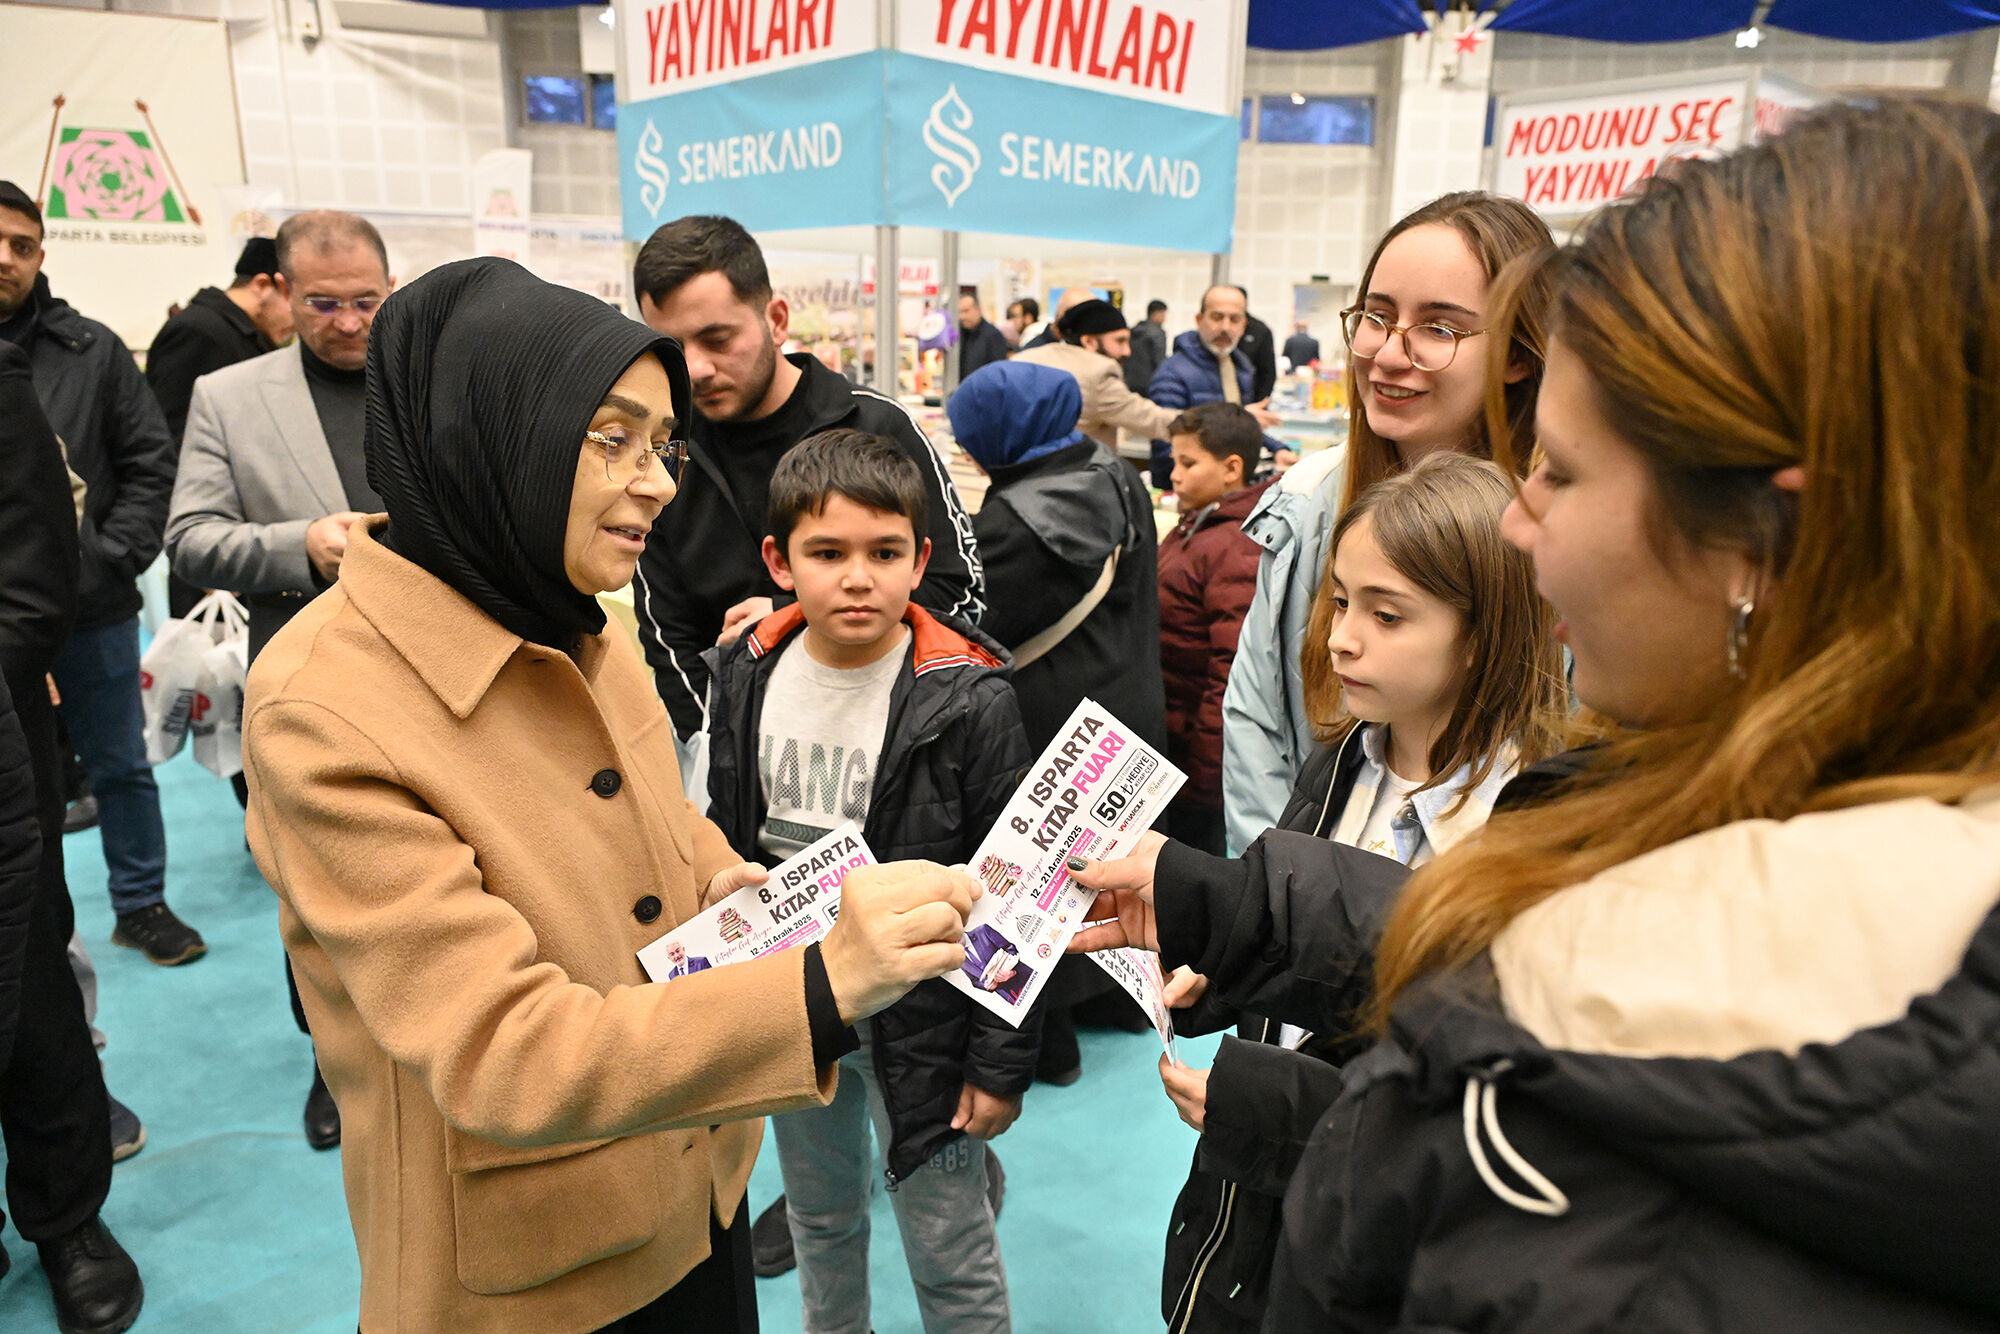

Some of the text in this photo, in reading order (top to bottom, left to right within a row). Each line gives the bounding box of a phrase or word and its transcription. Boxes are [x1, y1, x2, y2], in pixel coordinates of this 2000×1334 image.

[646, 0, 835, 85] YAYINLARI
[936, 0, 1195, 94] YAYINLARI
[678, 122, 842, 185] SEMERKAND
[1506, 105, 1660, 158] MODUNU
[1663, 98, 1734, 147] SEÇ
[999, 131, 1201, 199] SEMERKAND
[1010, 716, 1104, 834] 8. ISPARTA
[1031, 730, 1126, 852] KİTAP FUARI
[1096, 790, 1126, 821] 50
[758, 835, 858, 903] 8. ISPARTA
[1030, 888, 1040, 898] 12
[1040, 872, 1050, 884] 21
[1047, 848, 1067, 873] Aralık
[1063, 825, 1082, 848] 2025
[750, 947, 759, 955] 12
[763, 938, 772, 948] 21
[772, 926, 793, 942] Aralık
[793, 913, 811, 929] 2025
[768, 883, 819, 924] KİTAP
